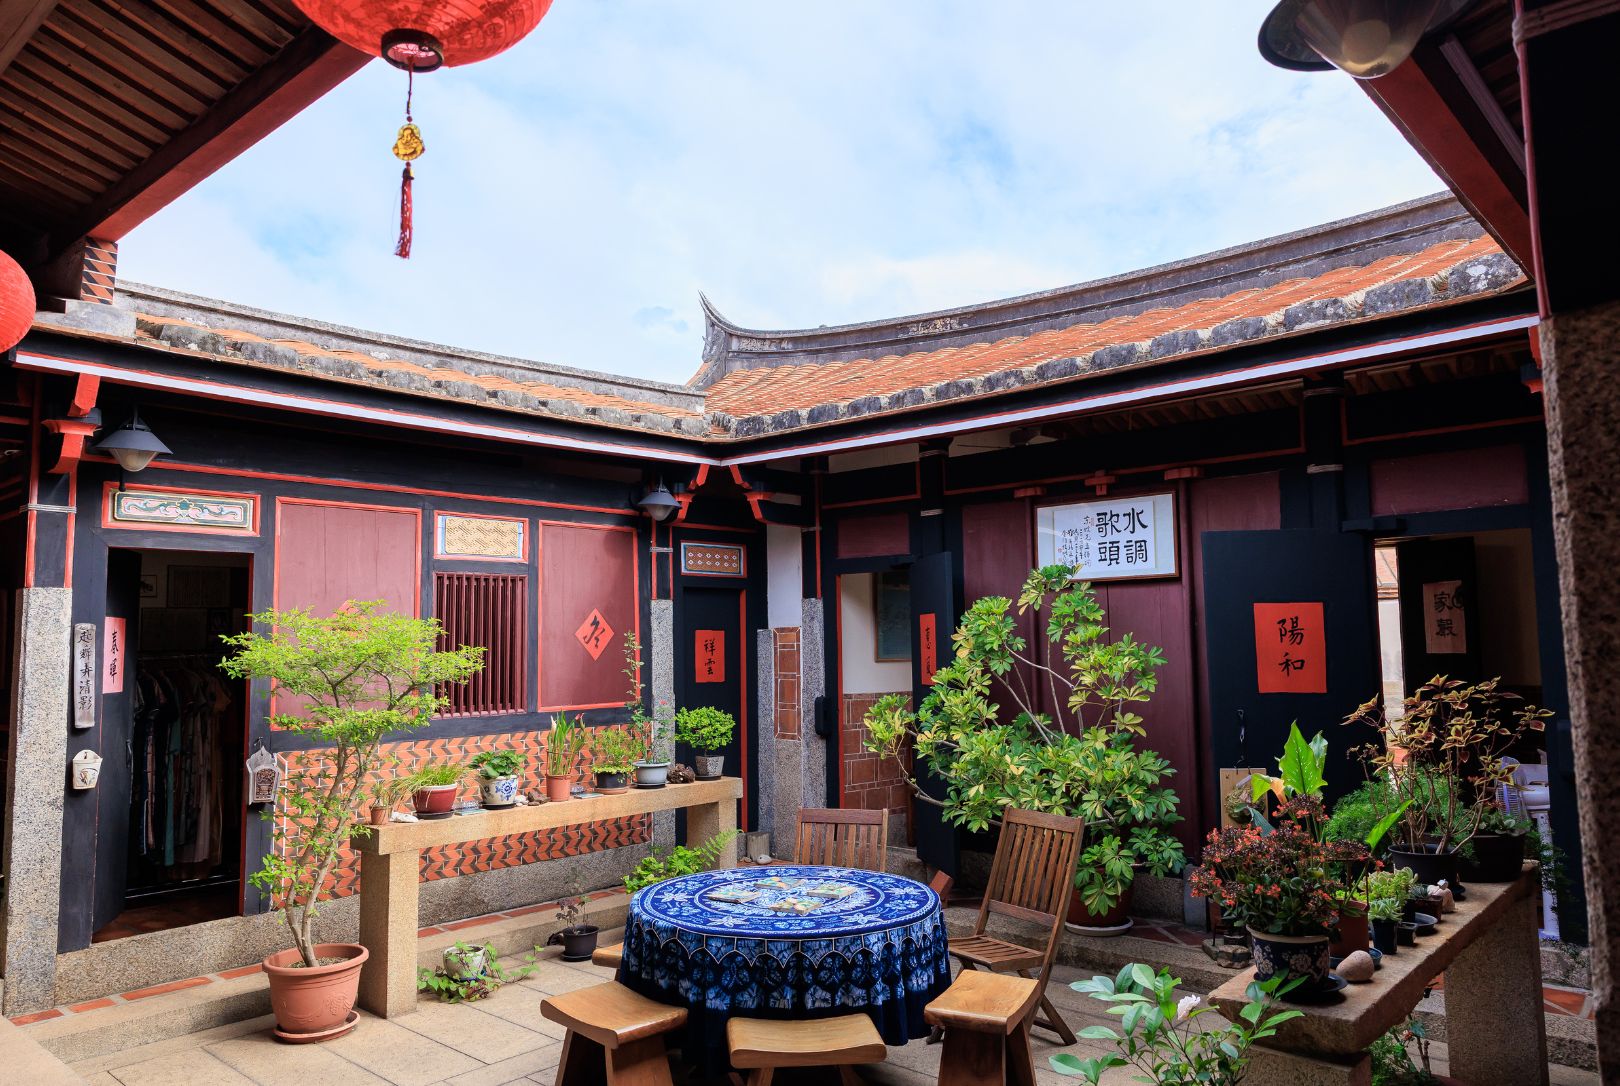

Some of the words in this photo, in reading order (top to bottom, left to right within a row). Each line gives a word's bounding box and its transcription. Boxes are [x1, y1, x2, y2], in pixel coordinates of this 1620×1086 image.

[1095, 509, 1121, 567] 歌頭
[1122, 507, 1149, 565] 水調
[704, 638, 716, 676] 祥雲
[1277, 616, 1305, 676] 陽和
